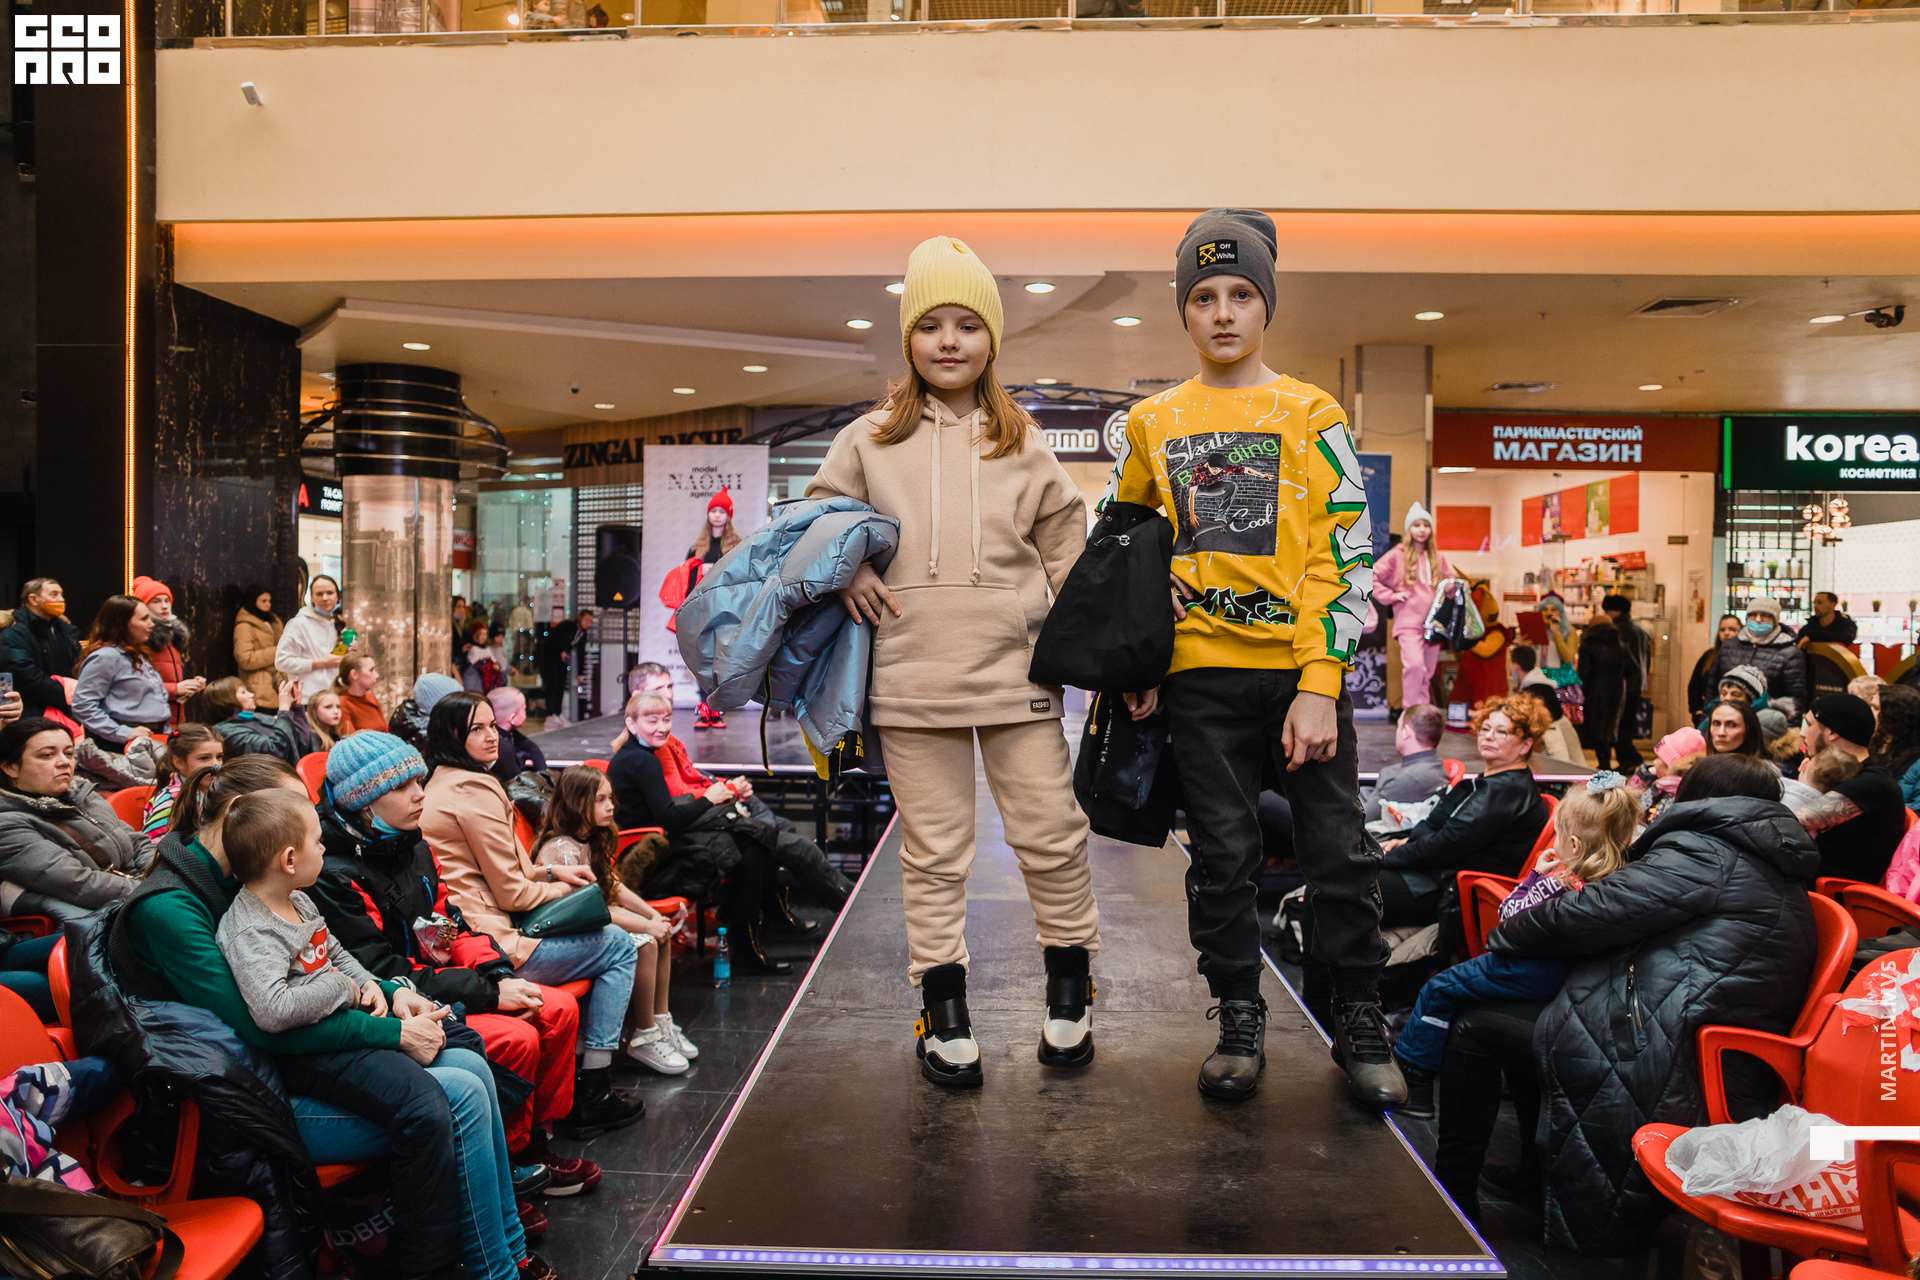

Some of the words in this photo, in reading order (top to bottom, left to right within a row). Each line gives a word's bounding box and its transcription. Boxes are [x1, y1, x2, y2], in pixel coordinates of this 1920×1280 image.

[1216, 252, 1236, 260] White
[1493, 425, 1643, 441] ПАРИКМАСТЕРСКИЙ
[1493, 441, 1643, 463] МАГАЗИН
[1785, 425, 1920, 463] korea
[1166, 431, 1238, 479] Skate
[667, 473, 743, 490] NAOMI
[1839, 468, 1917, 479] косметика
[1229, 502, 1274, 532] Cool
